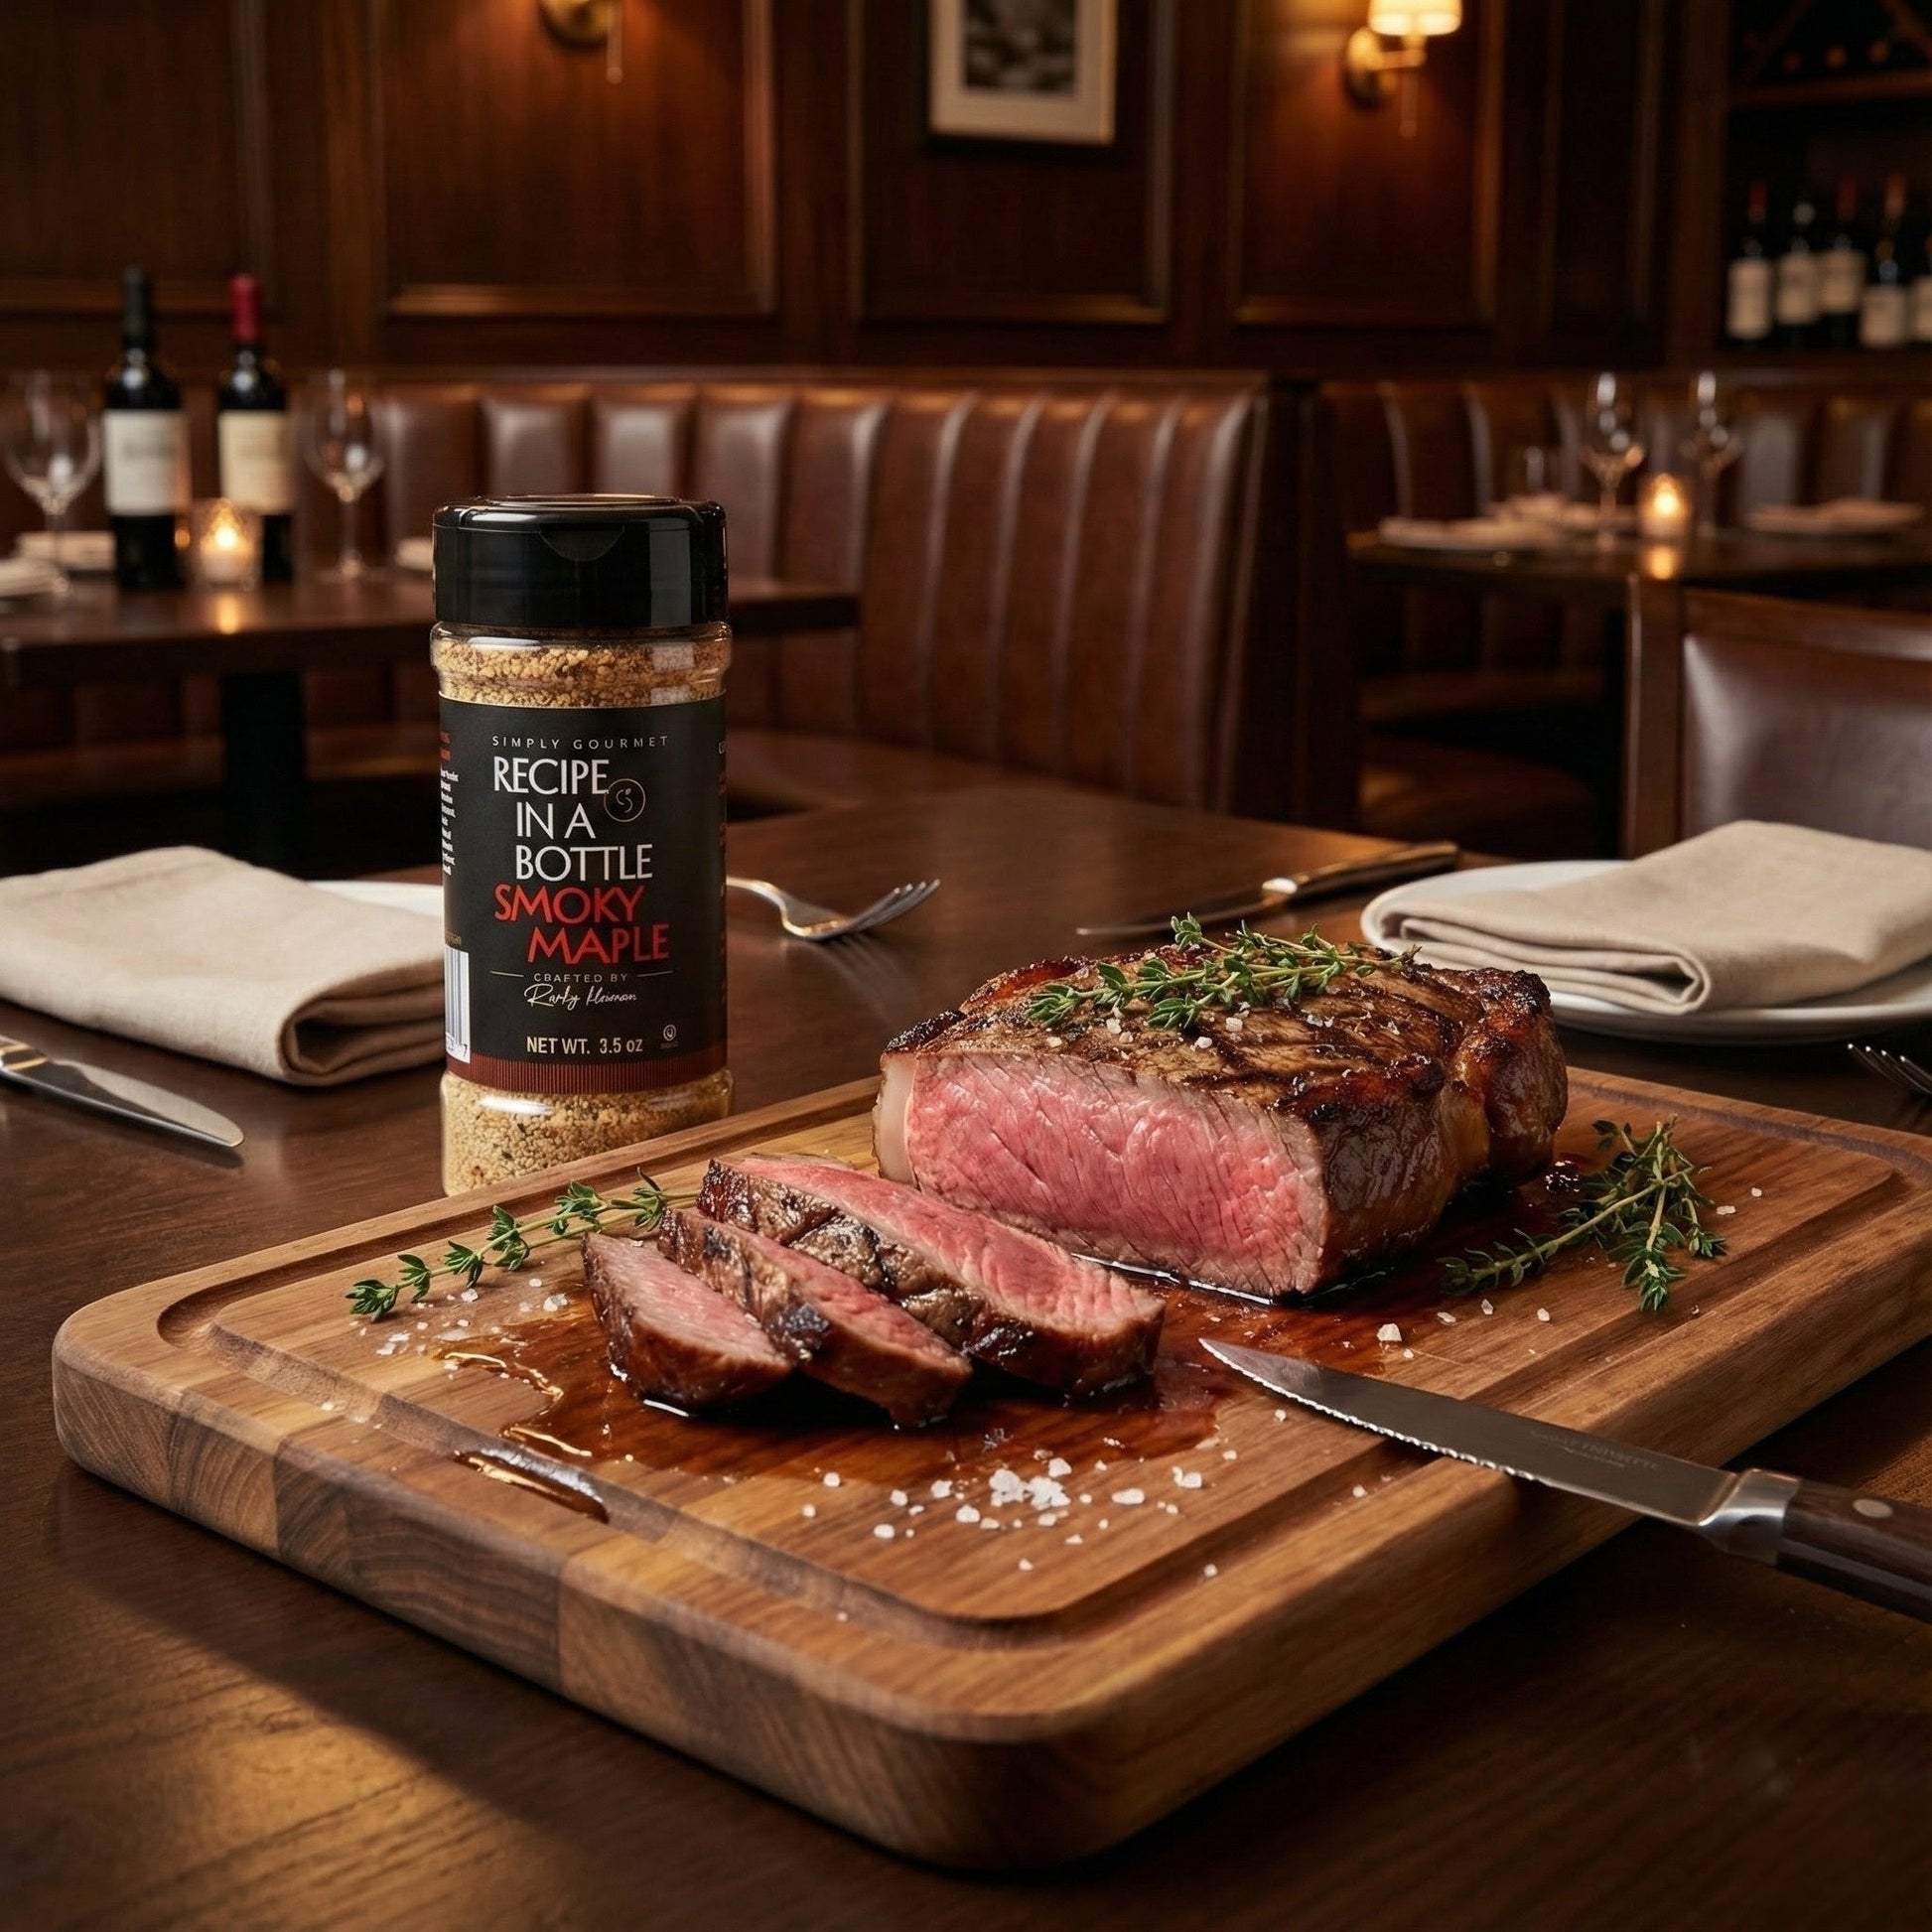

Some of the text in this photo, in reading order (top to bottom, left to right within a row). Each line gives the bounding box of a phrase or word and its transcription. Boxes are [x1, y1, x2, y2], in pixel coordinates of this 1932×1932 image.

[492, 736, 668, 750] SIMPLY GOURMET
[493, 757, 610, 795] RECIPE
[516, 801, 596, 840] IN A
[515, 844, 653, 882] BOTTLE
[493, 883, 644, 925] SMOKY
[527, 923, 670, 965] MAPLE
[533, 972, 628, 983] CRAFTED BY
[526, 1035, 557, 1053] NET
[561, 1037, 590, 1055] WT.
[599, 1037, 621, 1054] 3.5
